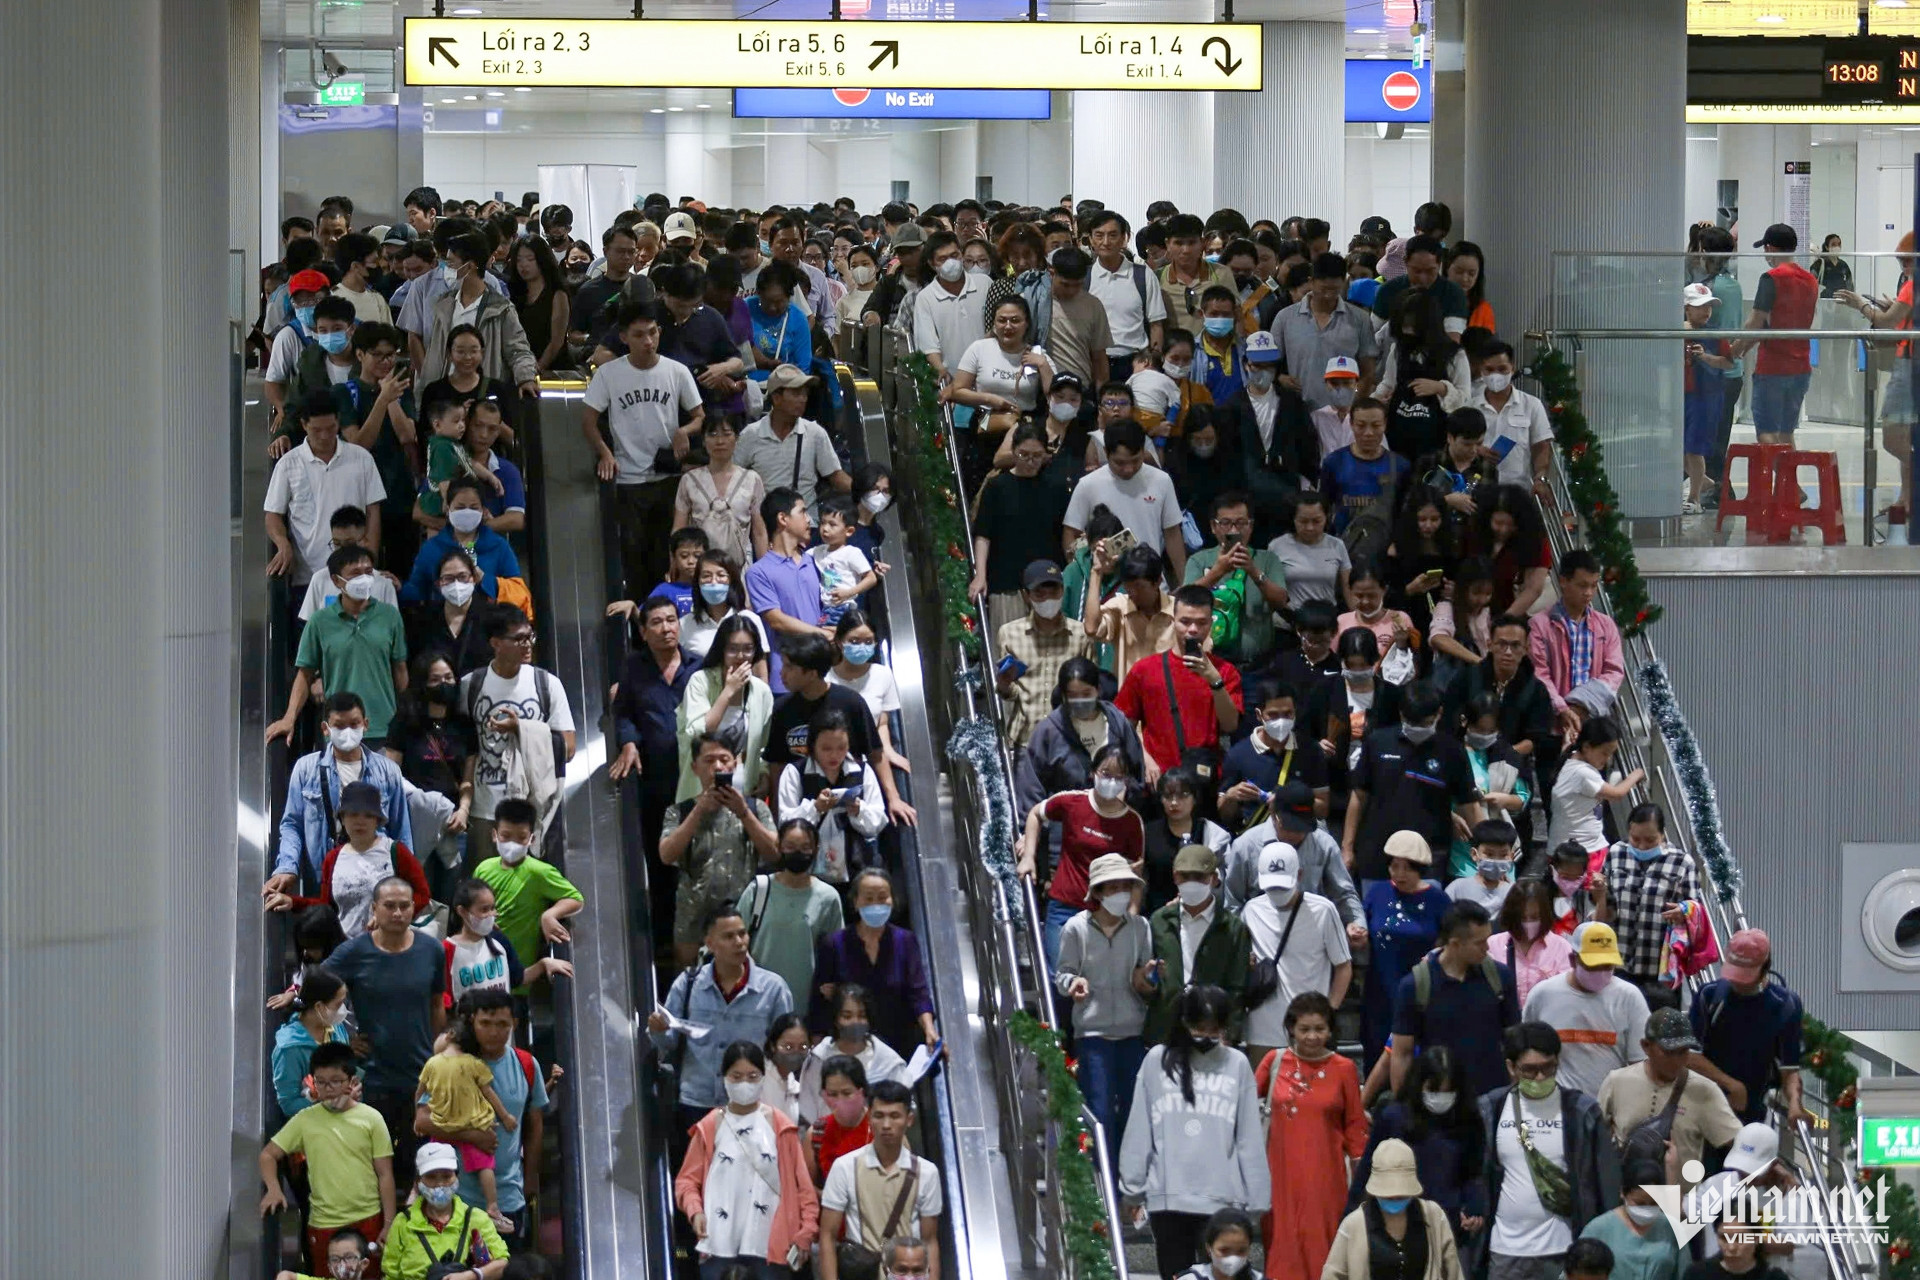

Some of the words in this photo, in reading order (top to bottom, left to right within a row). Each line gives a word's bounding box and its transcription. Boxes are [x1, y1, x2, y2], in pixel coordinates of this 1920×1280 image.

[483, 28, 515, 51] Lối
[523, 37, 545, 51] ra
[579, 32, 590, 51] 3
[738, 30, 770, 53] Lối
[779, 38, 800, 53] ra
[834, 34, 845, 53] 6
[1080, 32, 1112, 55] Lối
[1120, 41, 1141, 55] ra
[1170, 36, 1183, 55] 4
[483, 59, 510, 74] Exit
[534, 60, 543, 74] 3
[785, 61, 813, 76] Exit
[837, 62, 845, 76] 6
[1126, 63, 1154, 78] Exit
[1174, 64, 1183, 78] 4
[1829, 64, 1879, 82] 13:08
[885, 91, 906, 107] No
[908, 91, 935, 107] Exit
[618, 388, 671, 410] JORDAN
[1500, 1119, 1532, 1128] GAE
